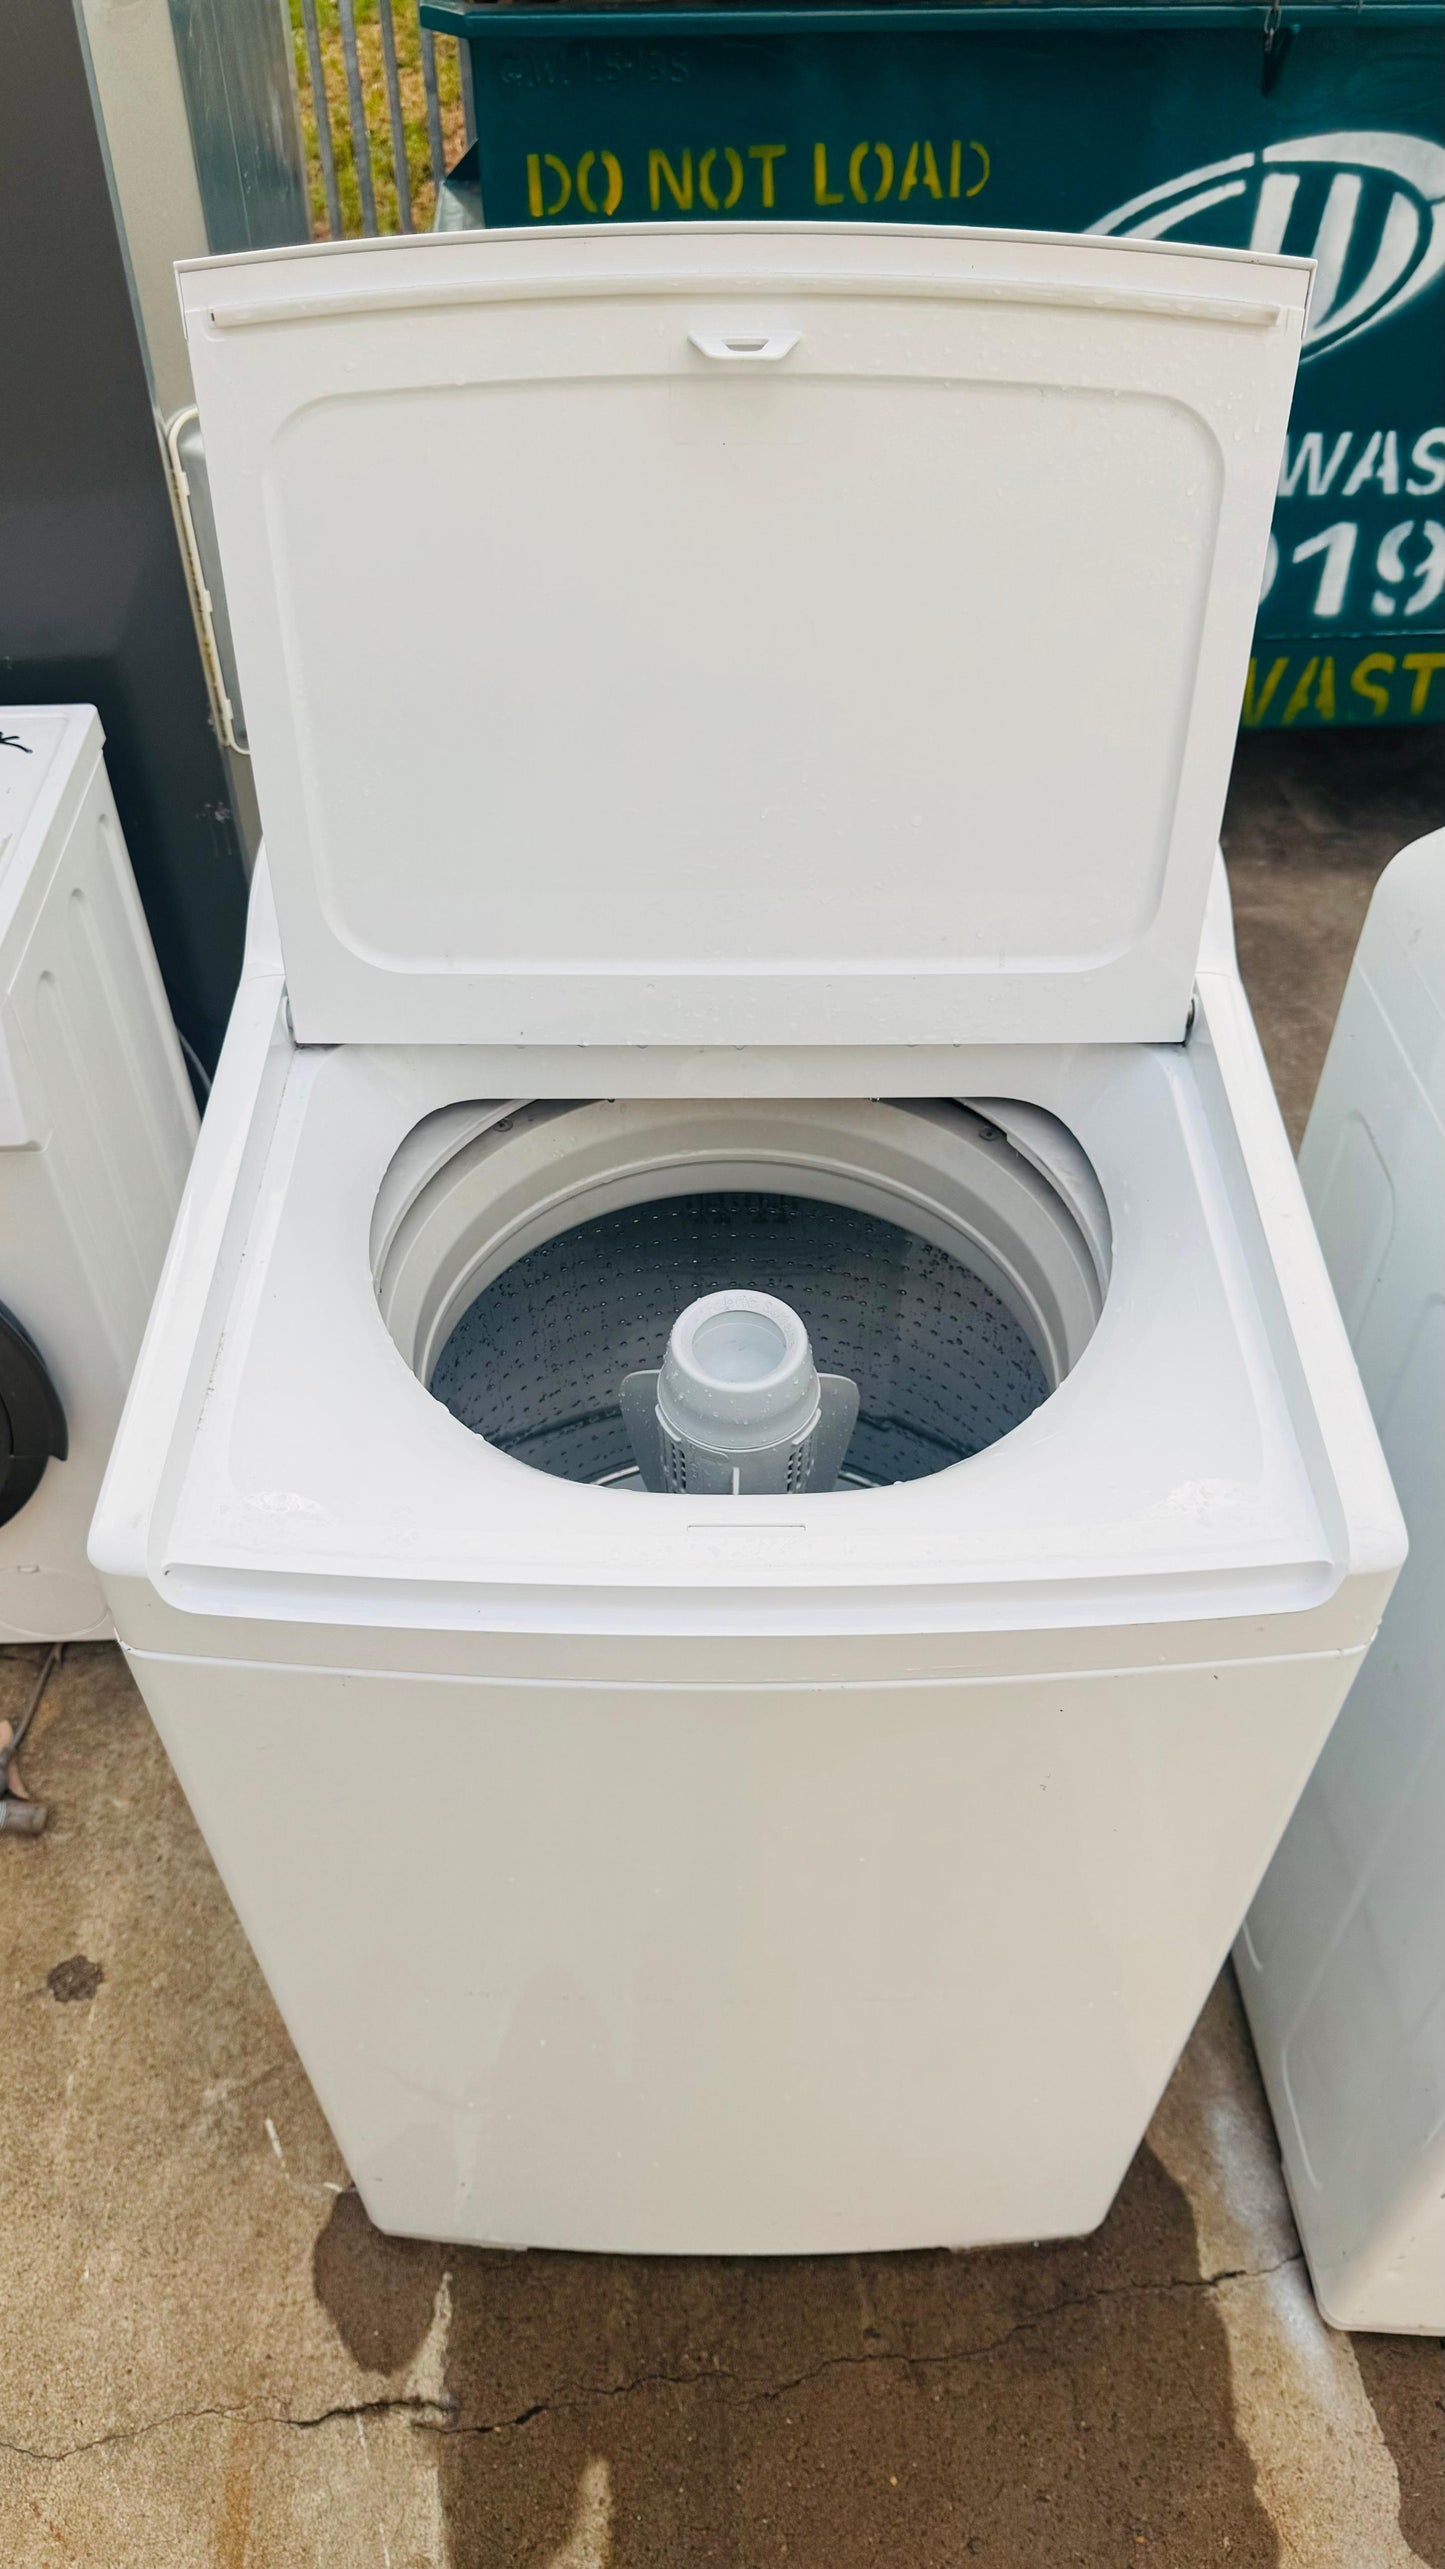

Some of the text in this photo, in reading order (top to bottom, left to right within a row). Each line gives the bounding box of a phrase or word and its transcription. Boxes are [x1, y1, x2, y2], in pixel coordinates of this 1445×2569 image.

[526, 139, 991, 217] DO NOT LOAD
